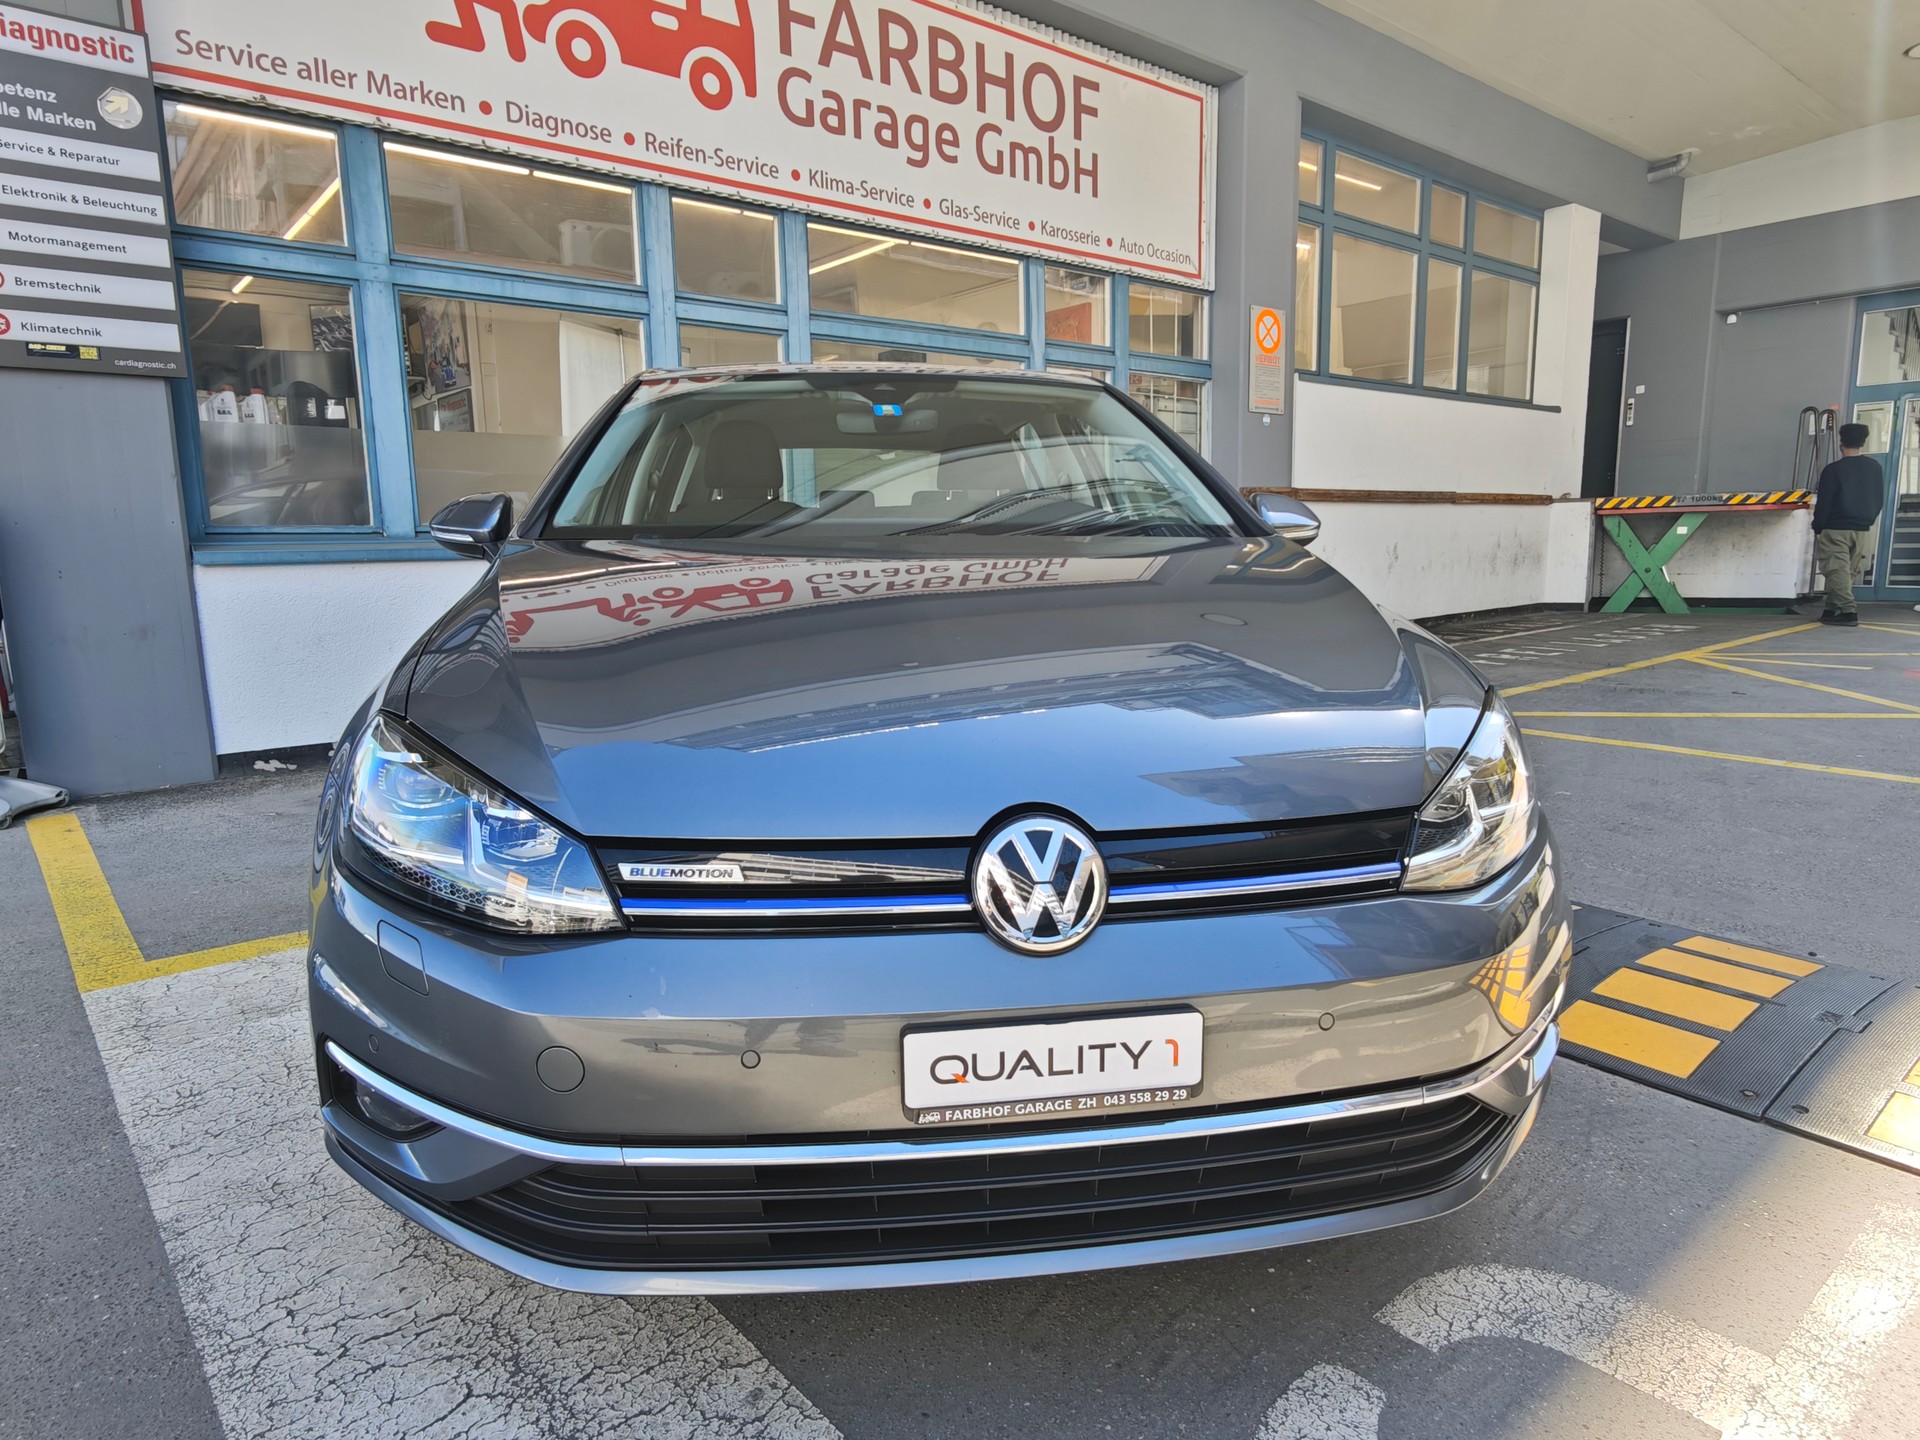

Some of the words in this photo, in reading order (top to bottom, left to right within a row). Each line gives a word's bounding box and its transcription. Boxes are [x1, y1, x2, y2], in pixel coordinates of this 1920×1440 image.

[777, 0, 1101, 141] FARBHOF
[26, 105, 97, 131] Marken
[777, 66, 960, 169] Garage
[975, 121, 1099, 199] GmbH
[47, 146, 56, 156] &
[60, 148, 120, 166] Reparatur
[174, 28, 288, 76] Service
[296, 56, 358, 90] aller
[366, 71, 467, 114] Marken
[505, 100, 613, 144] Diagnose
[644, 132, 780, 180] Reifen-Service
[807, 168, 916, 209] Klima-Service
[938, 198, 1021, 231] Glas-Service
[1040, 219, 1102, 248] Karosserie
[1118, 236, 1145, 256] Auto
[1146, 242, 1193, 267] Occasion
[1, 184, 68, 203] Elektronik
[71, 194, 79, 204] &
[83, 195, 159, 217] Beleuchtung
[8, 231, 128, 254] Motormanagement
[14, 276, 102, 294] Bremstechnik
[20, 321, 103, 337] Klimatechnik
[114, 358, 177, 370] cardiagnostic.ch
[629, 867, 734, 878] BLUEMOTION
[929, 1038, 1154, 1085] QUALITY
[1165, 1038, 1179, 1067] 1
[945, 1103, 1012, 1122] FARBHOF
[1014, 1098, 1073, 1115] GARAGE
[1078, 1097, 1097, 1109] ZH
[1103, 1094, 1126, 1106] 043
[1129, 1091, 1152, 1104] 558
[1154, 1089, 1170, 1102] 29
[1172, 1088, 1188, 1101] 29
